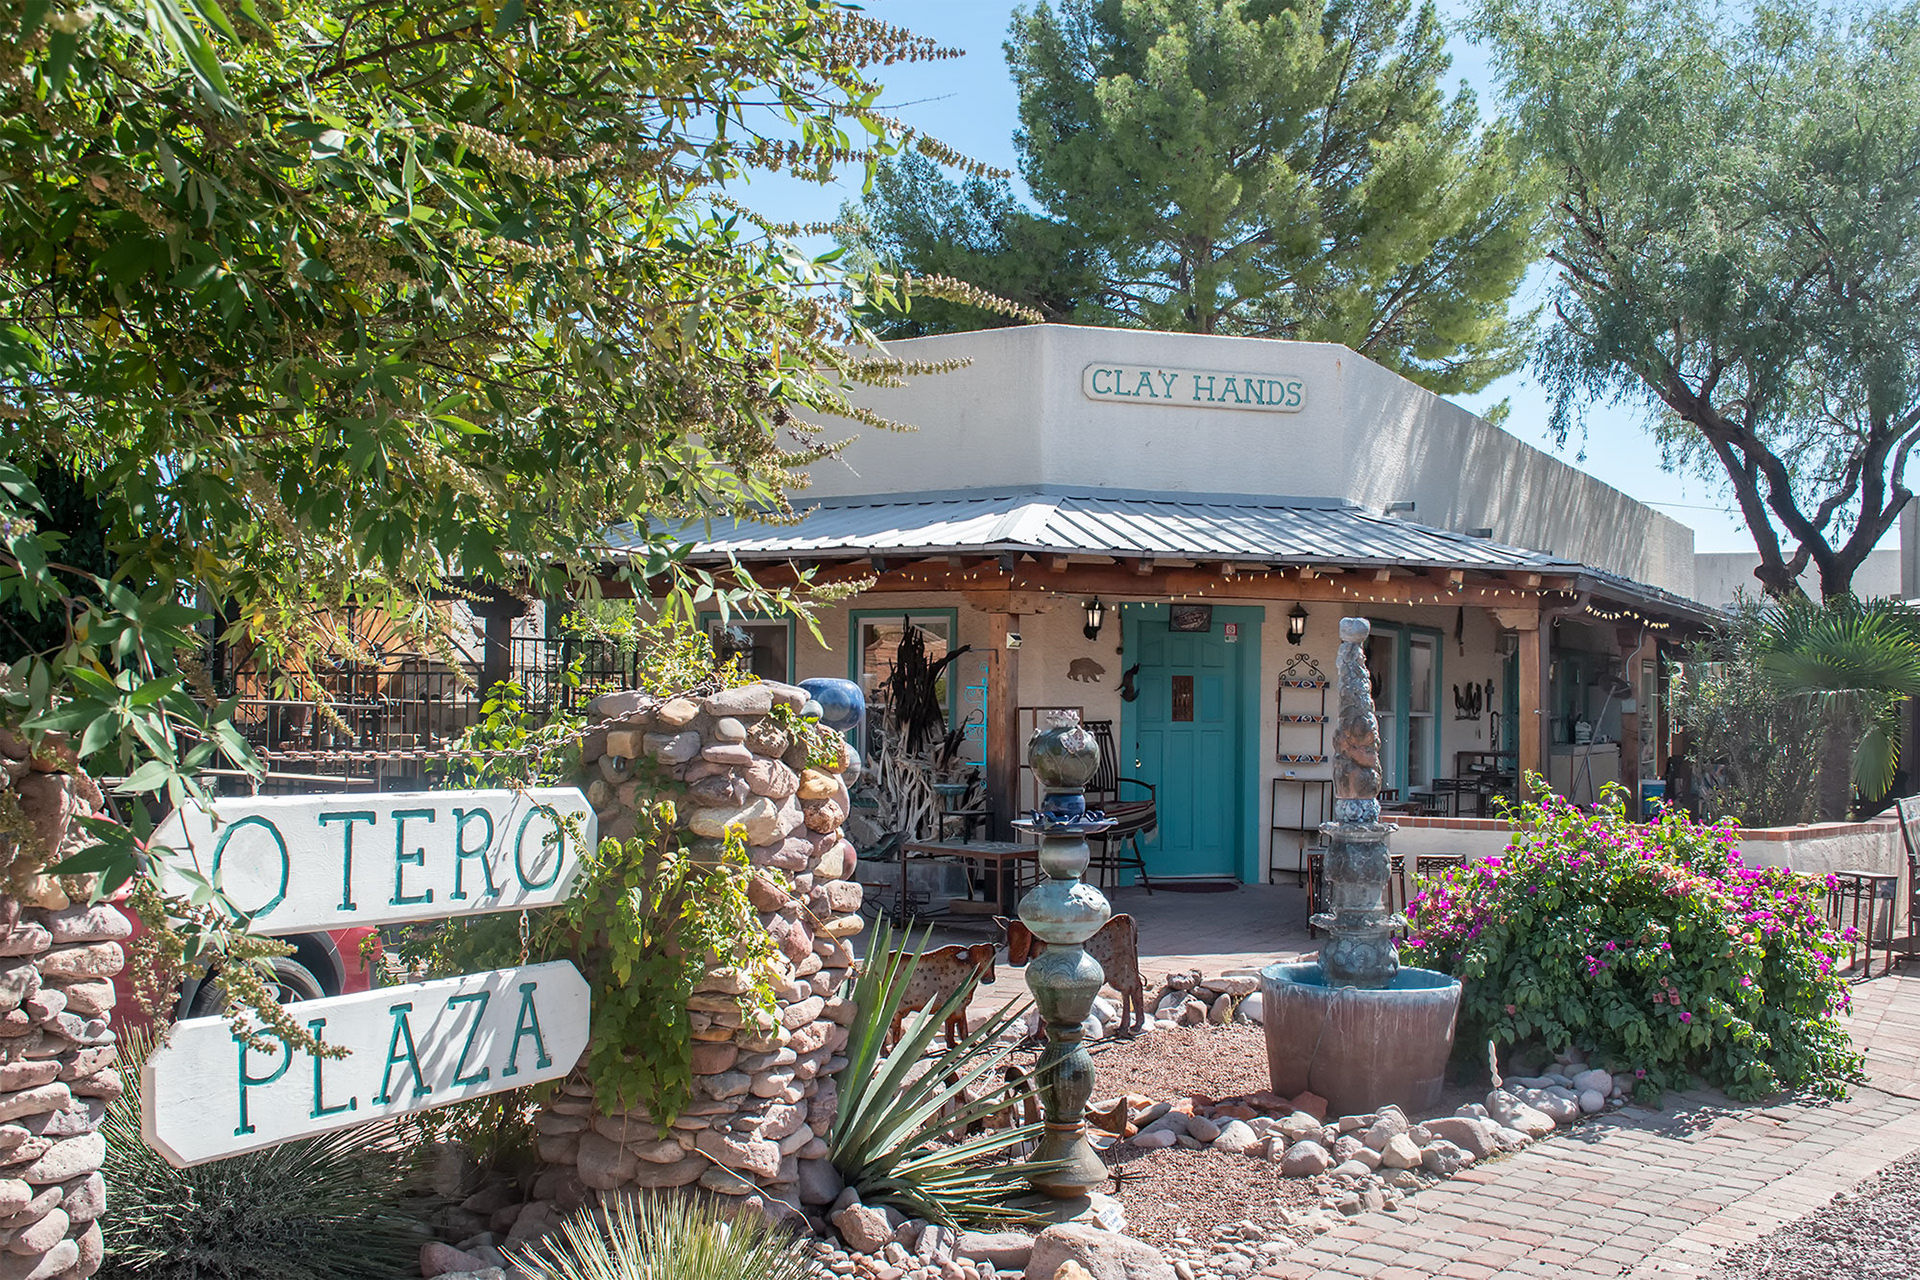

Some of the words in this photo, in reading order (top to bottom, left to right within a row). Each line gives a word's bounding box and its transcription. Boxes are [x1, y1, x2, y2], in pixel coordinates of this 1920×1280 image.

[1092, 369, 1178, 398] CLAY
[1193, 375, 1303, 407] HANDS
[213, 805, 565, 918] OTERO
[232, 982, 552, 1136] PLAZA
